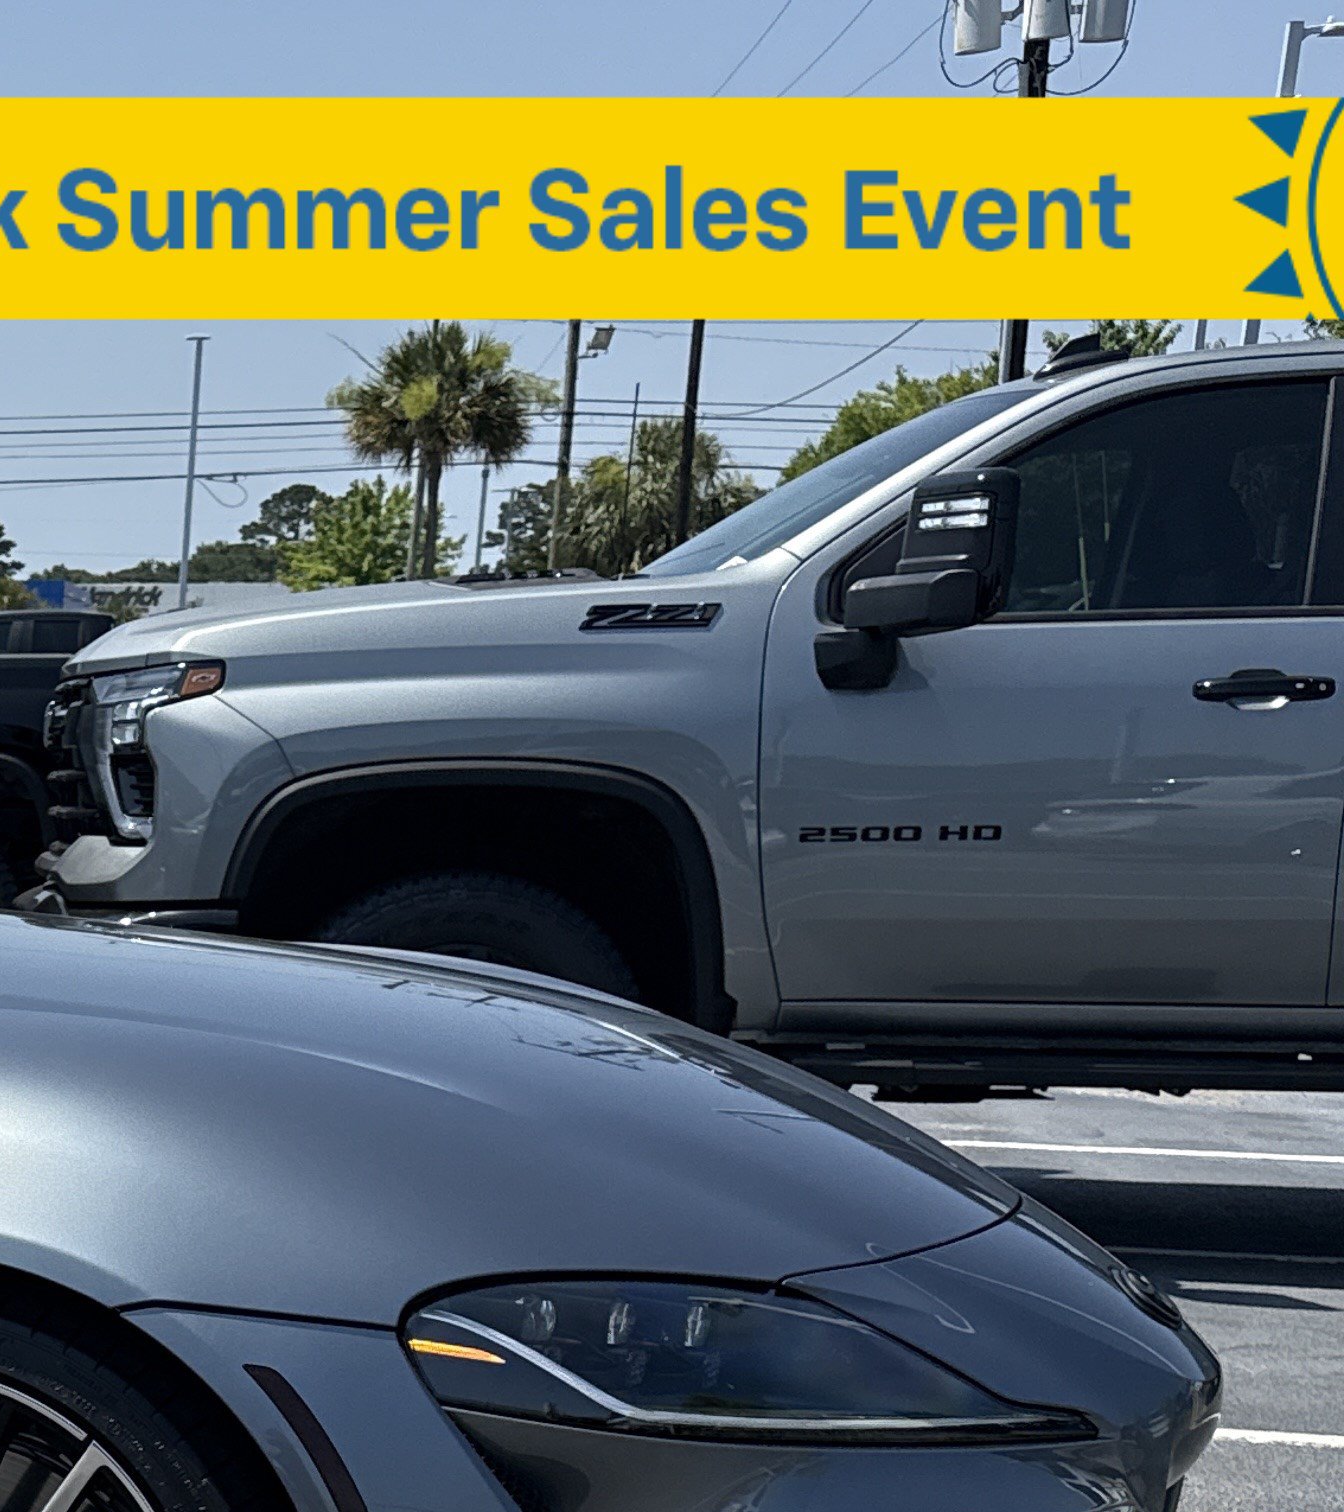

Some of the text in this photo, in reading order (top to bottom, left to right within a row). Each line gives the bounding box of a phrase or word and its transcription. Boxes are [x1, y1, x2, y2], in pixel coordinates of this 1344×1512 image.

[579, 602, 724, 632] Z71
[799, 825, 1002, 843] 2500 HD
